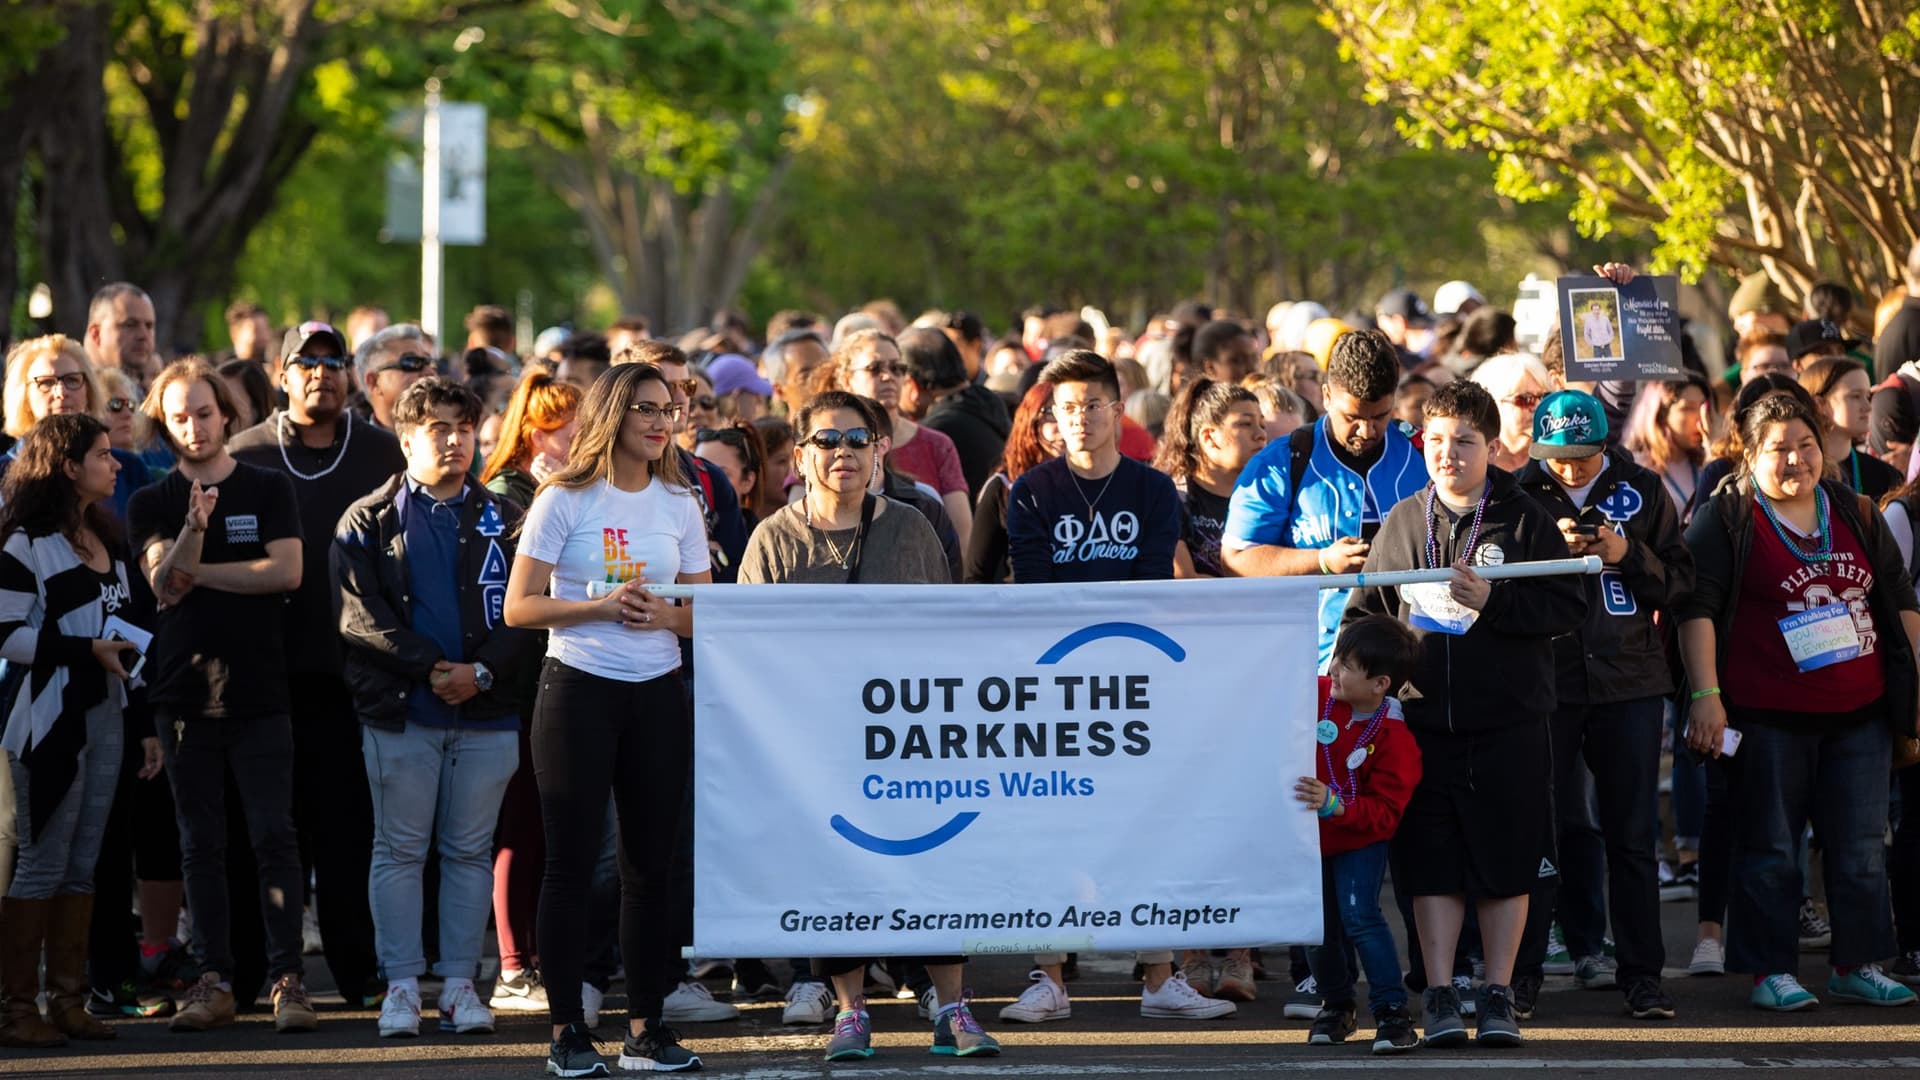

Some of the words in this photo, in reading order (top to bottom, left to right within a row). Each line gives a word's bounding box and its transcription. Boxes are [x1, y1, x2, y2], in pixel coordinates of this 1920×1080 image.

[1540, 411, 1591, 438] Sharks
[1054, 511, 1140, 547] ΦΔΘ
[603, 528, 632, 562] BE
[1051, 541, 1076, 564] al
[1780, 563, 1828, 593] PLEAS
[1797, 610, 1831, 625] Walking
[1831, 607, 1844, 615] For
[862, 678, 963, 714] OUT
[977, 676, 1039, 712] OF
[1055, 675, 1150, 710] THE
[865, 720, 1151, 760] DARKNESS
[862, 774, 990, 804] Campus
[1000, 770, 1095, 797] Walks
[780, 909, 883, 932] Greater
[889, 907, 1053, 931] Sacramento
[1059, 905, 1122, 928] Area
[1130, 903, 1241, 932] Chapter
[976, 942, 1020, 953] Campus
